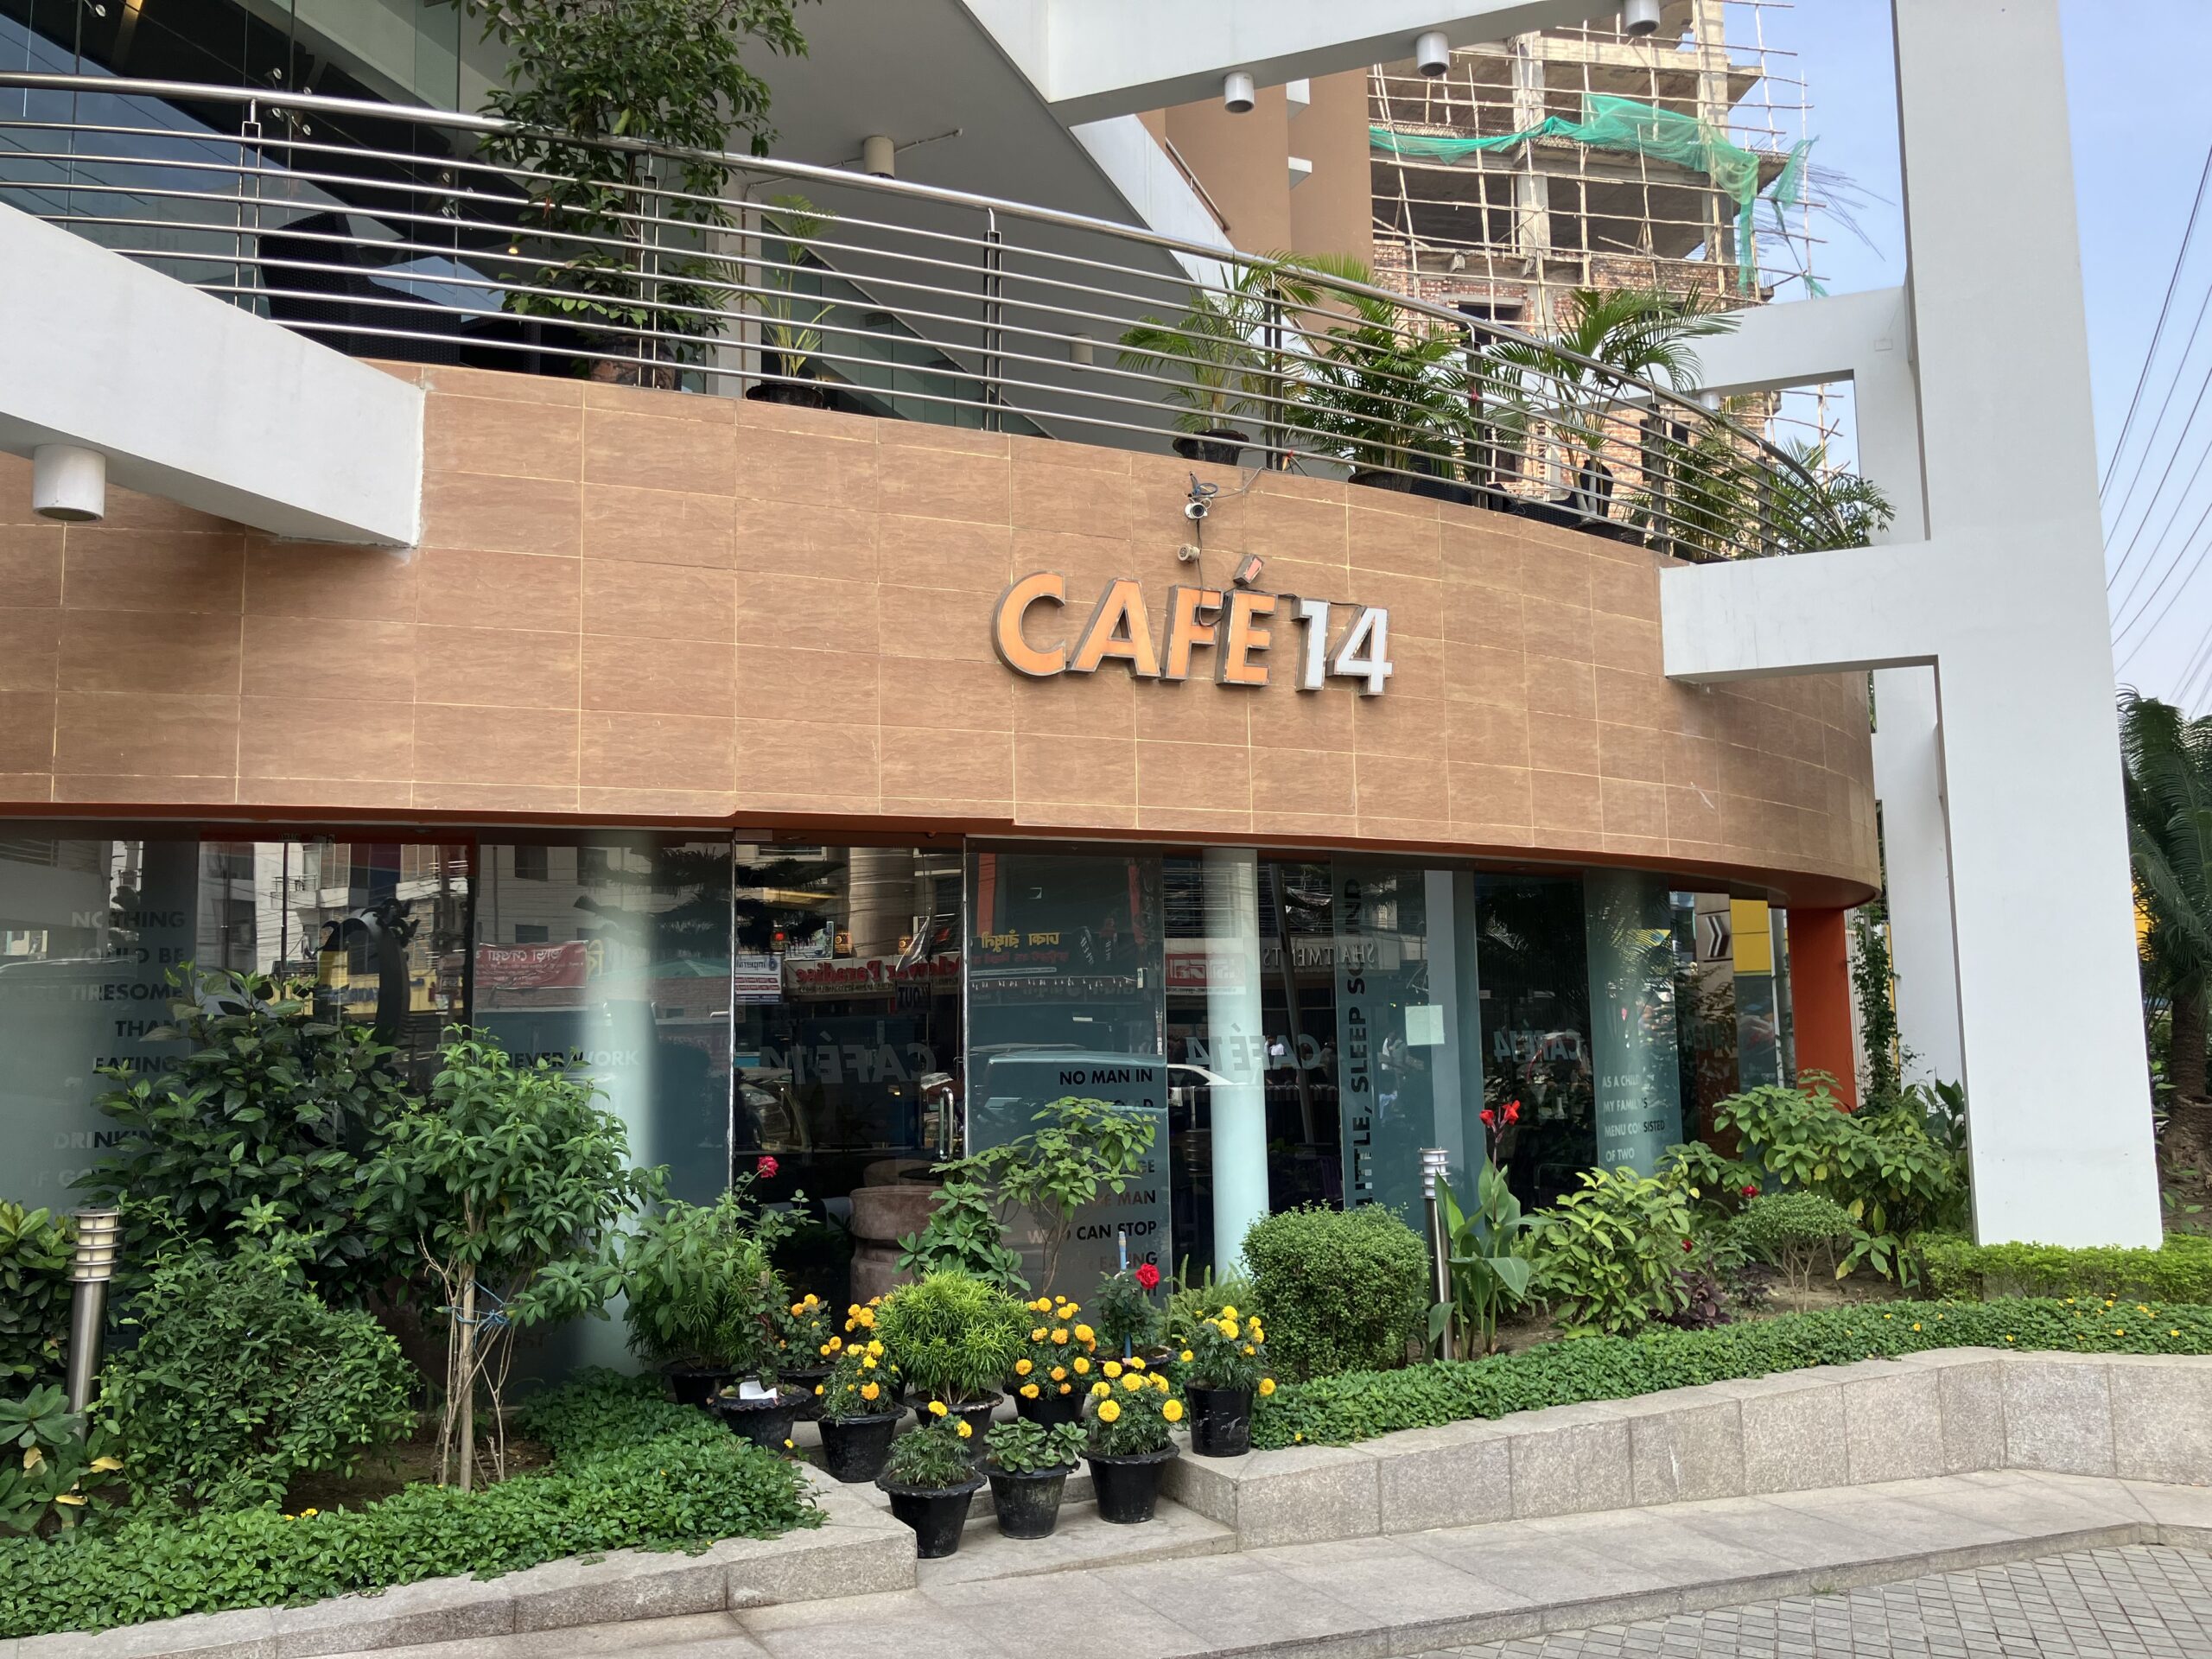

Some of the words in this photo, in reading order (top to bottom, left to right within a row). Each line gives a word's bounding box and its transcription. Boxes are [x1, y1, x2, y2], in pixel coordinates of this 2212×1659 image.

[991, 555, 1279, 687] CAFÉ
[1291, 597, 1395, 697] 14
[1344, 878, 1365, 995] SOND
[159, 947, 184, 963] BE
[70, 982, 184, 1001] TIRESOME
[1349, 1006, 1370, 1093] SLEEP
[1059, 1071, 1086, 1085] NO
[1090, 1069, 1130, 1084] MAN
[1135, 1068, 1153, 1082] IN
[1602, 1076, 1612, 1088] AS
[1613, 1076, 1619, 1087] A
[1603, 1100, 1615, 1112] MY
[1604, 1124, 1626, 1137] MENU
[1352, 1105, 1374, 1206] LITTLE,
[1605, 1150, 1616, 1162] OF
[1618, 1147, 1636, 1160] TWO
[1117, 1190, 1156, 1207] MAN
[1077, 1224, 1112, 1241] CAN
[1117, 1220, 1157, 1236] STOP
[1099, 1251, 1158, 1270] EAING
